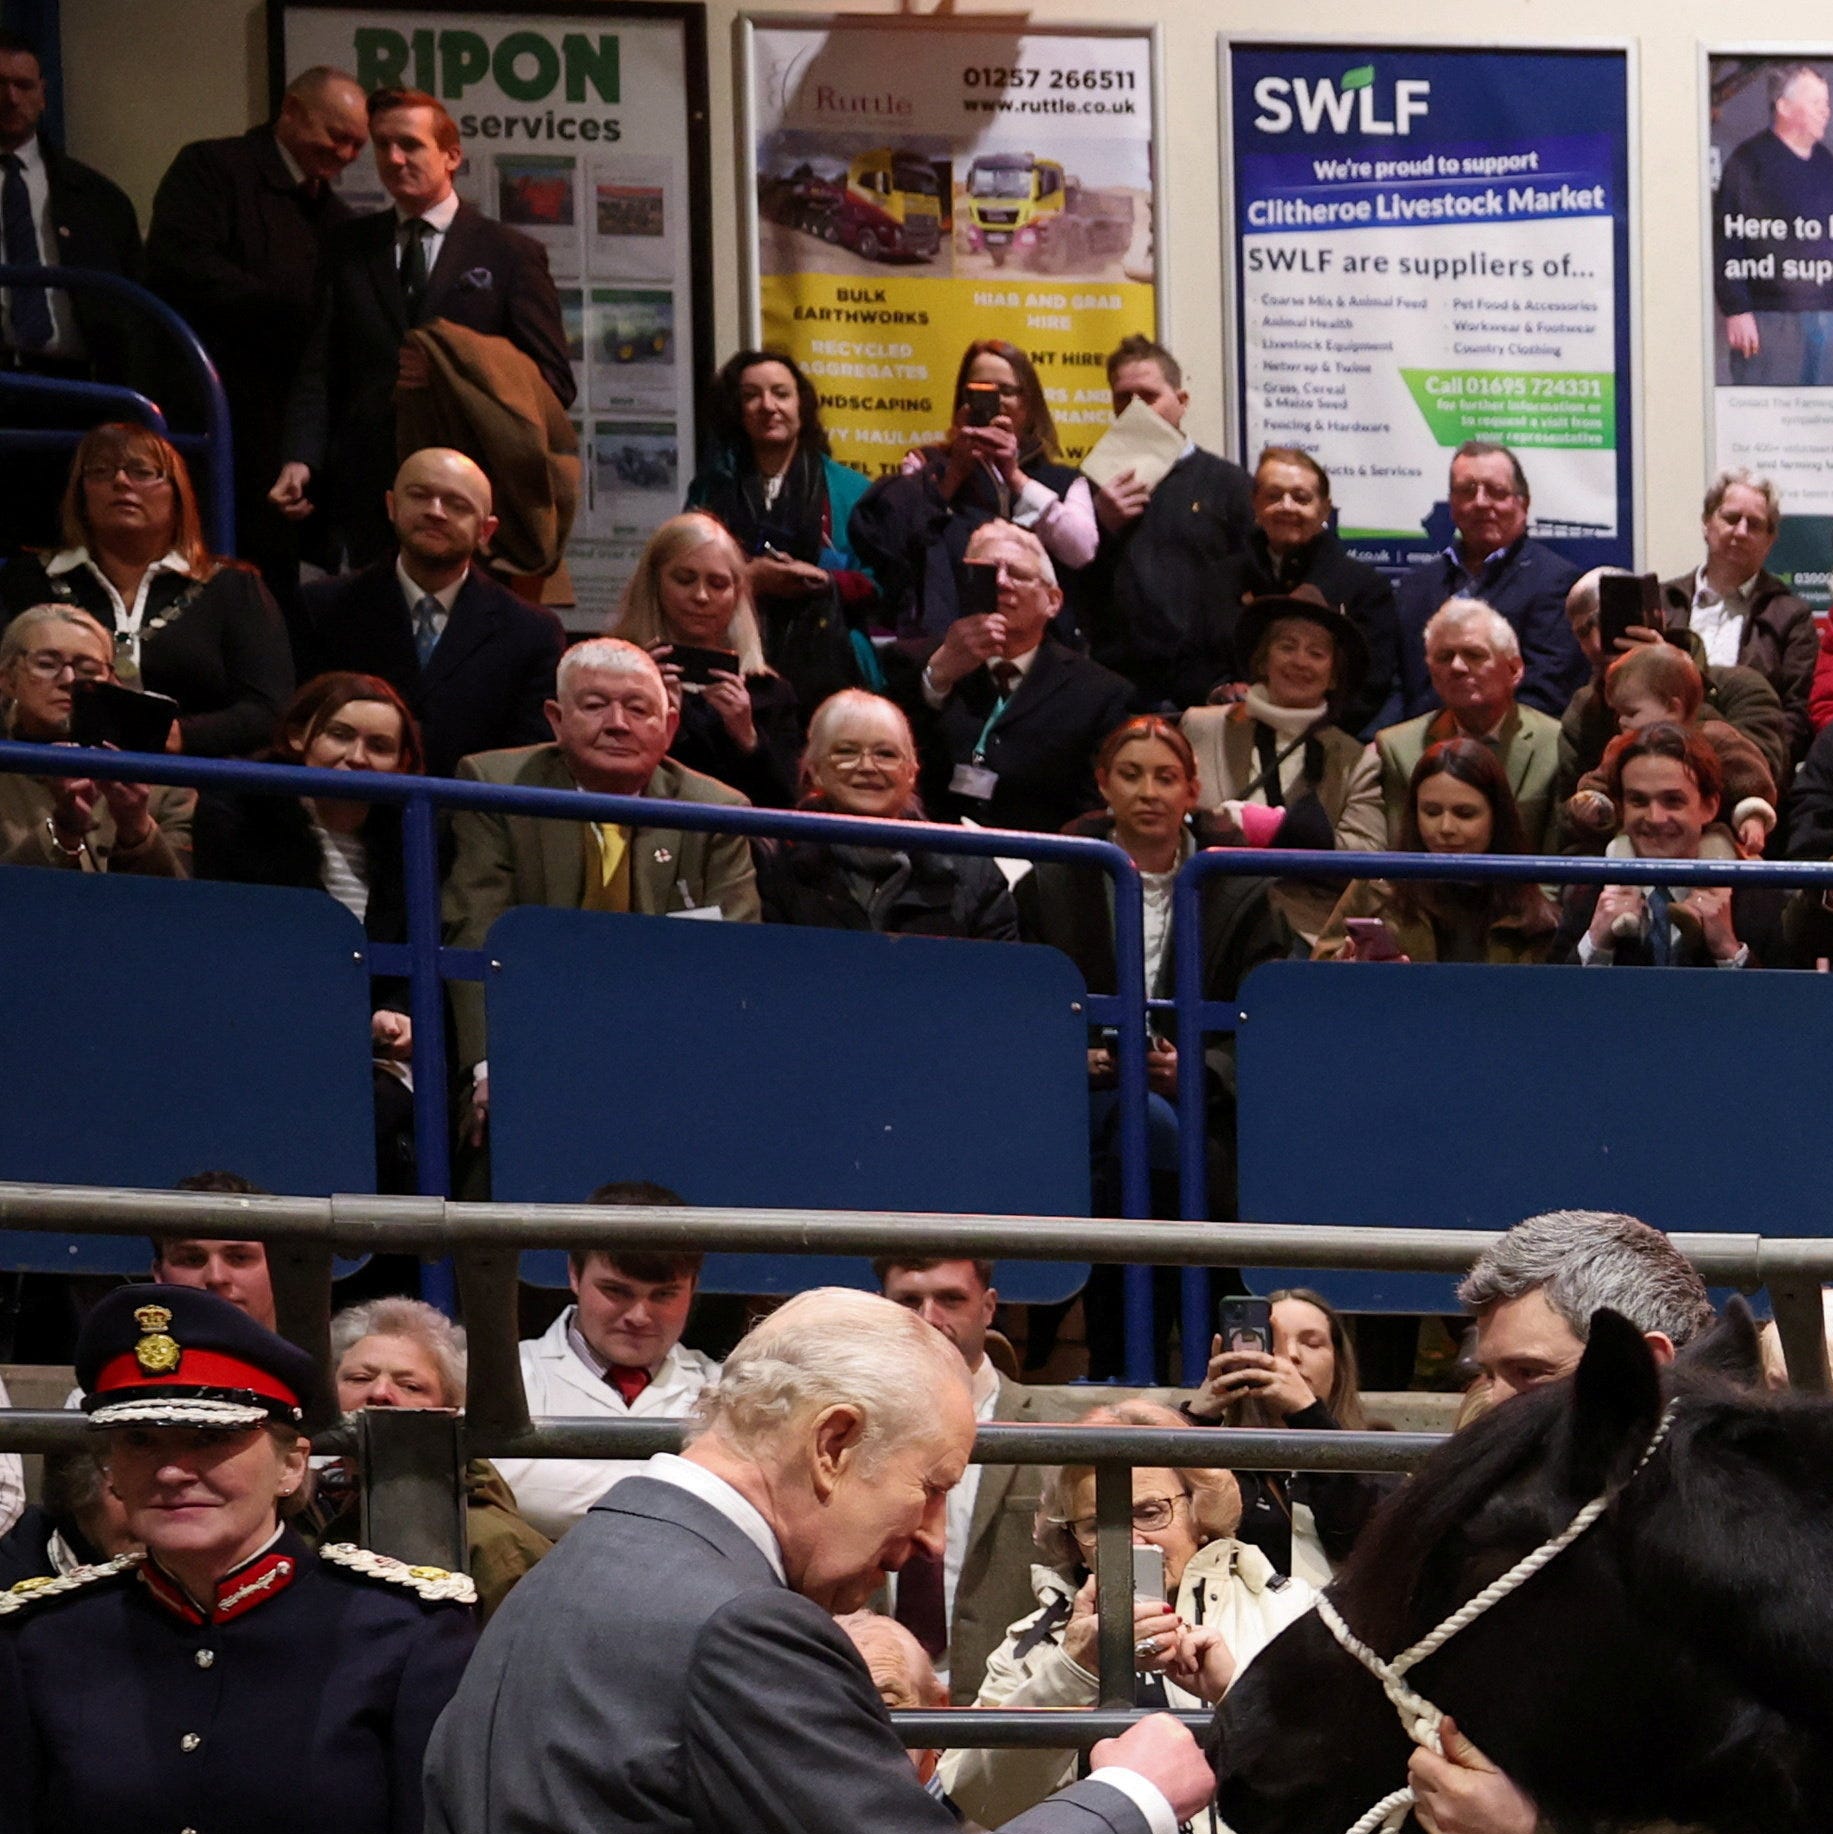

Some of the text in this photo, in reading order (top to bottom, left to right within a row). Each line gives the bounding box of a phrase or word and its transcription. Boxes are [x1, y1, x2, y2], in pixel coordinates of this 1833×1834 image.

[354, 27, 620, 104] RIPON
[963, 67, 1136, 90] 01257 266511
[963, 97, 1136, 115] www.ruttle.co.uk
[1253, 75, 1431, 136] SWLF
[460, 110, 621, 142] services
[1313, 150, 1539, 181] We're proud to support
[1248, 184, 1606, 227] Clitheroe Livestock Market
[1723, 213, 1788, 240] Here
[1795, 215, 1823, 240] to
[1249, 248, 1595, 281] SWLF are suppliers of...
[1724, 252, 1775, 280] and
[836, 287, 887, 304] BULK
[1025, 293, 1068, 310] AND
[793, 305, 930, 326] EARTHWORKS
[811, 339, 914, 359] RECYCLED
[1424, 374, 1601, 398] Call 01695 724331
[819, 393, 933, 413] NDSCAPING
